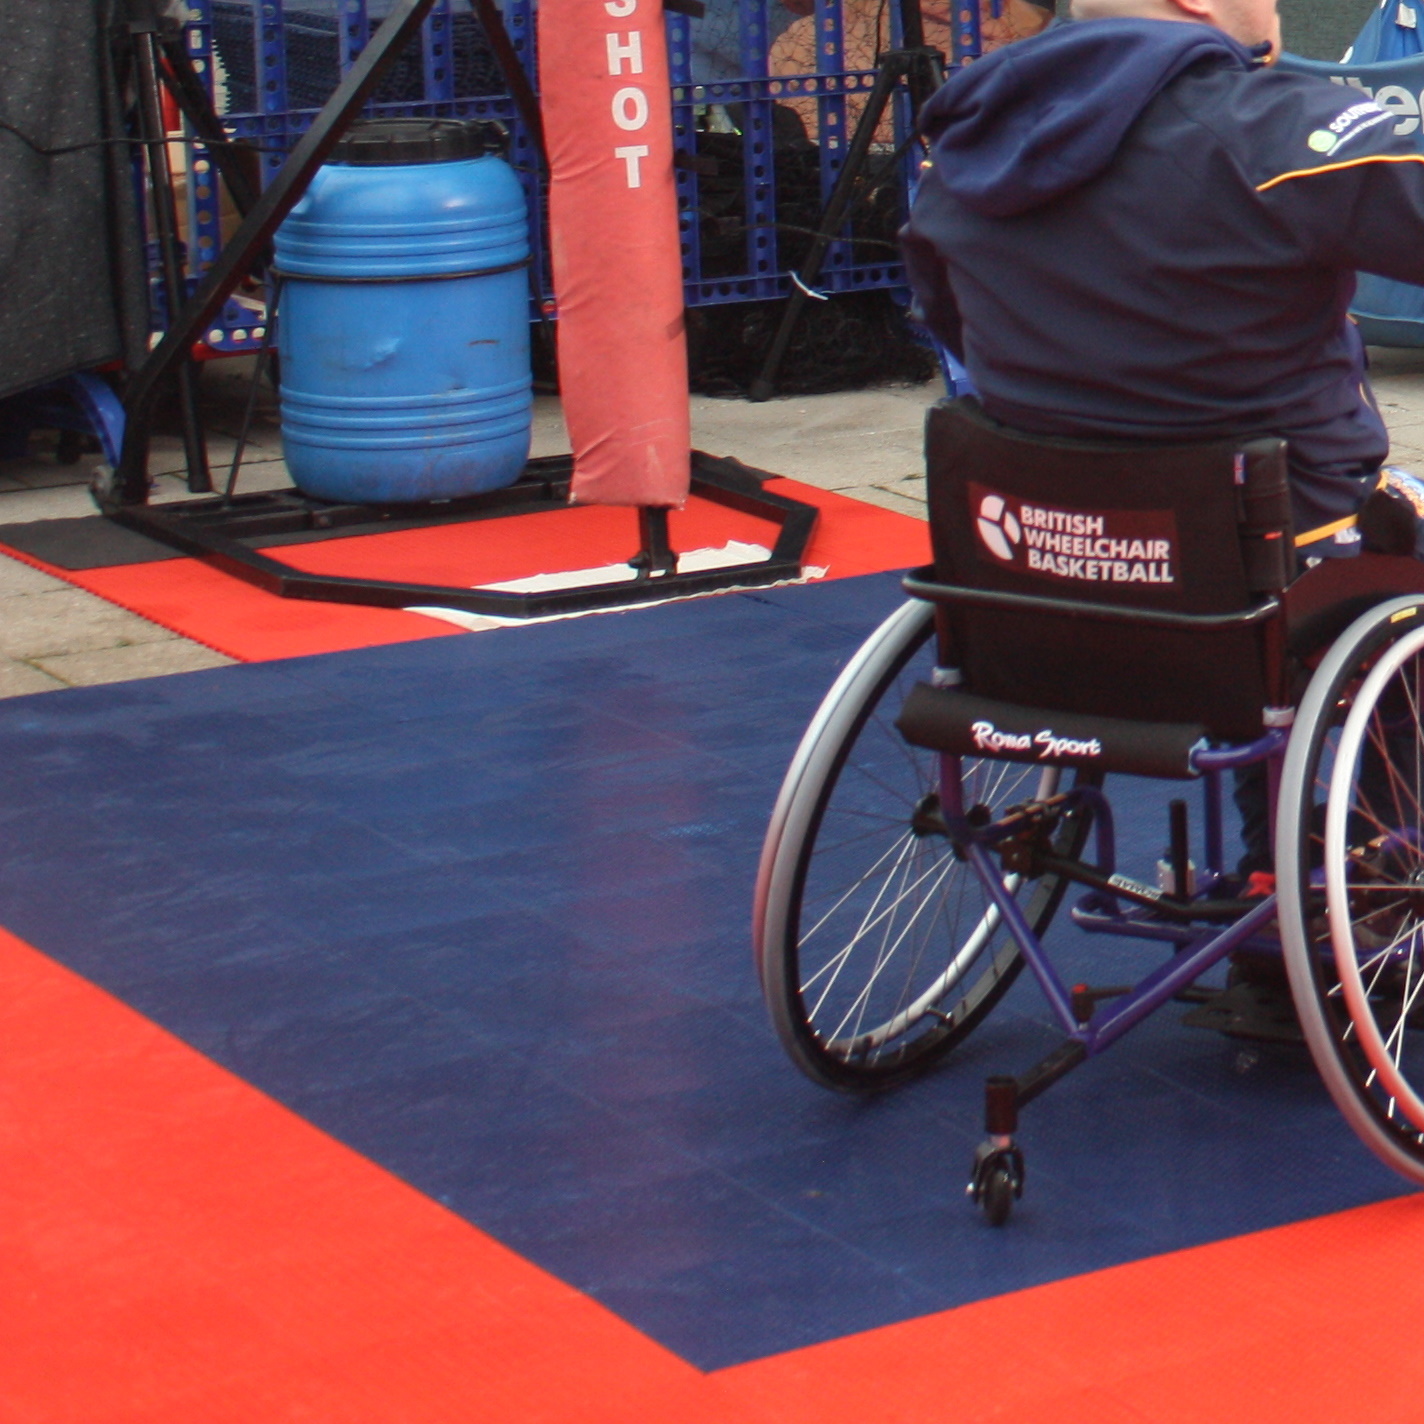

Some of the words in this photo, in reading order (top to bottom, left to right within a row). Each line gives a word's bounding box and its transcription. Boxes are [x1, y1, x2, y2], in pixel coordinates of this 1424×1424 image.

[1020, 505, 1104, 536] BRITISH
[1023, 527, 1171, 560] WHEELCHAIR
[1028, 548, 1174, 583] BASKETBALL
[971, 720, 1031, 752] Roma
[1034, 729, 1102, 759] Sport
